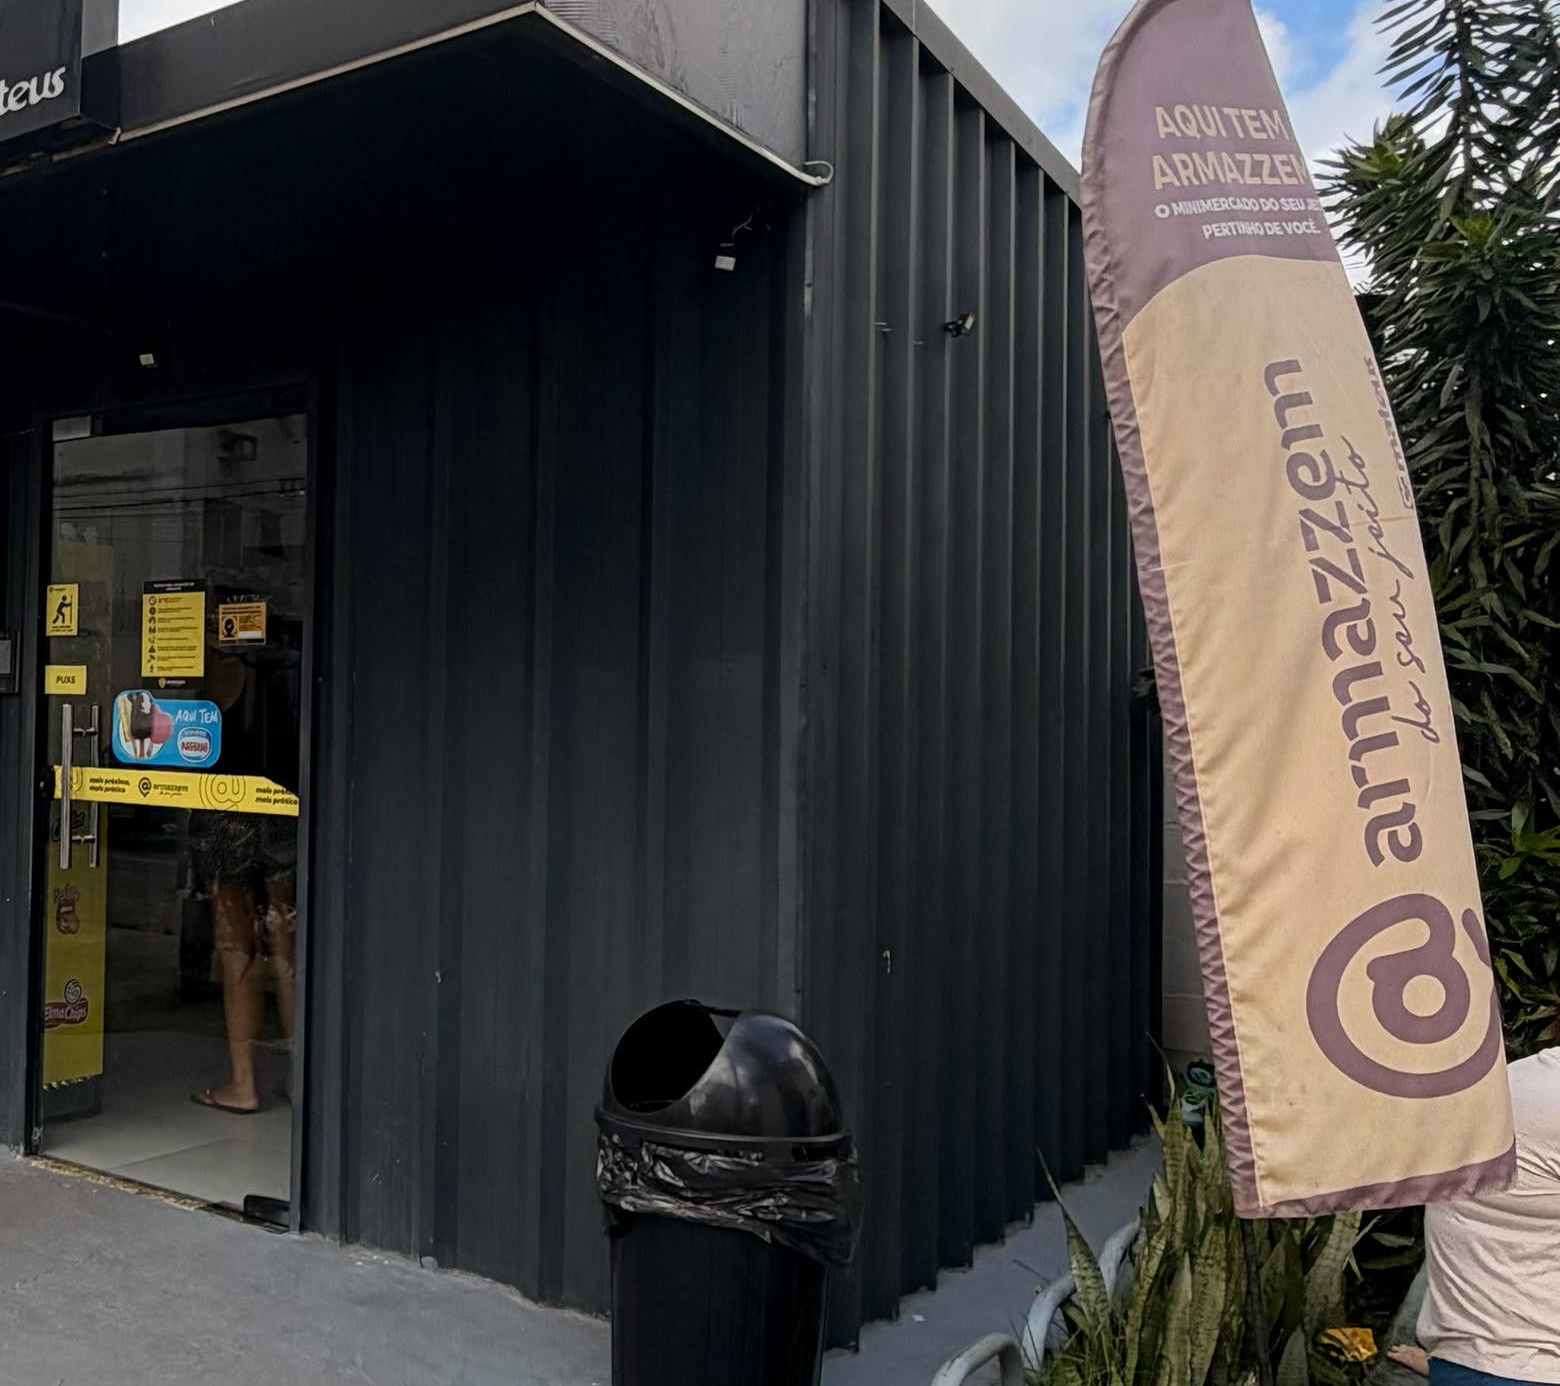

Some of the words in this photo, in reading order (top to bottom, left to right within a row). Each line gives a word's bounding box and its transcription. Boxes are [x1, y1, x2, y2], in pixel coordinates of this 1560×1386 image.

[1154, 103, 1227, 140] AQUI
[1222, 106, 1290, 141] TEM
[1153, 203, 1170, 219] O
[1170, 196, 1260, 216] MINIMERCADO
[1259, 197, 1280, 212] DO
[1279, 197, 1306, 211] SEU
[1201, 220, 1265, 240] PERTINHO
[1265, 221, 1284, 236] DE
[1333, 434, 1415, 581] jeito
[1263, 358, 1424, 869] armazzem
[1388, 578, 1427, 675] seu
[55, 674, 77, 686] PUXE
[175, 708, 198, 723] AQUI
[1390, 680, 1441, 745] do
